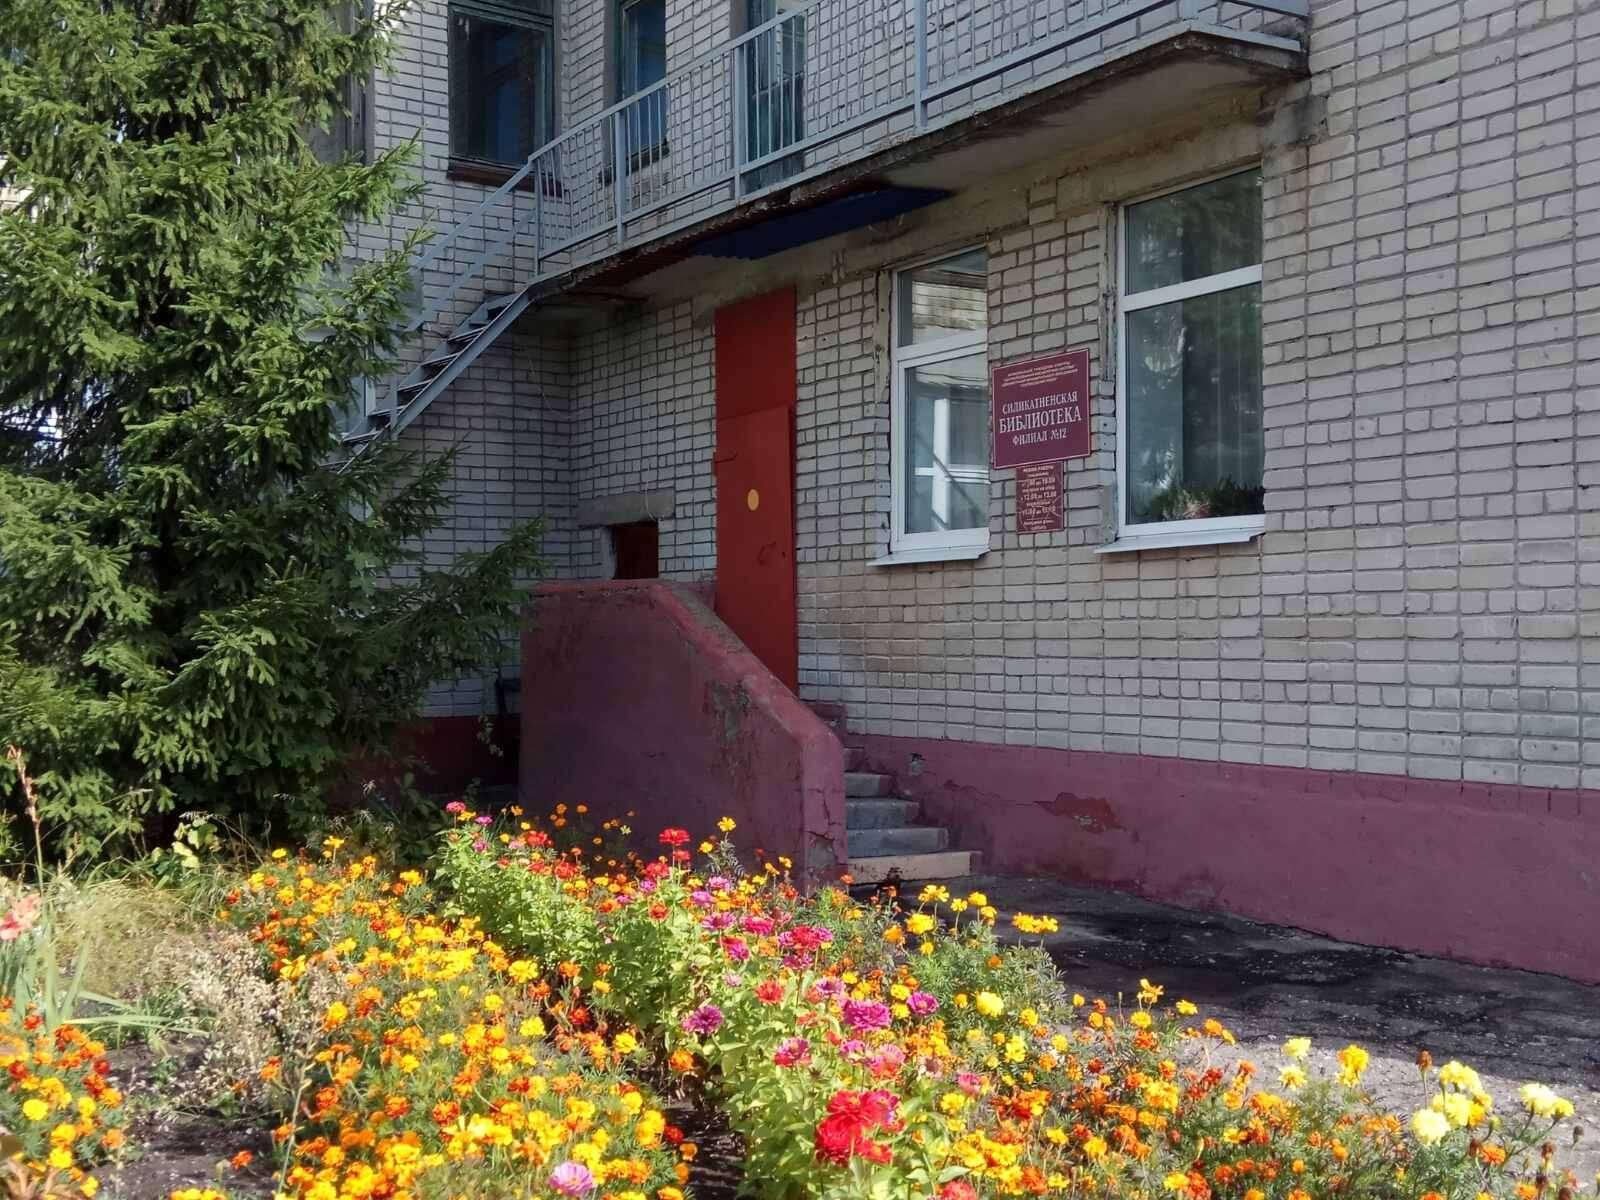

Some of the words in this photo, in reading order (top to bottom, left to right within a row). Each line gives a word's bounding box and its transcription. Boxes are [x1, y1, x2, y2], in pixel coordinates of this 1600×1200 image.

[1002, 391, 1078, 414] СИЛИКАТНЕНСКАЯ
[1000, 406, 1082, 434] БИБЛИОТЕКА
[1012, 430, 1048, 446] ФИЛИАЛ
[1050, 428, 1067, 441] №12
